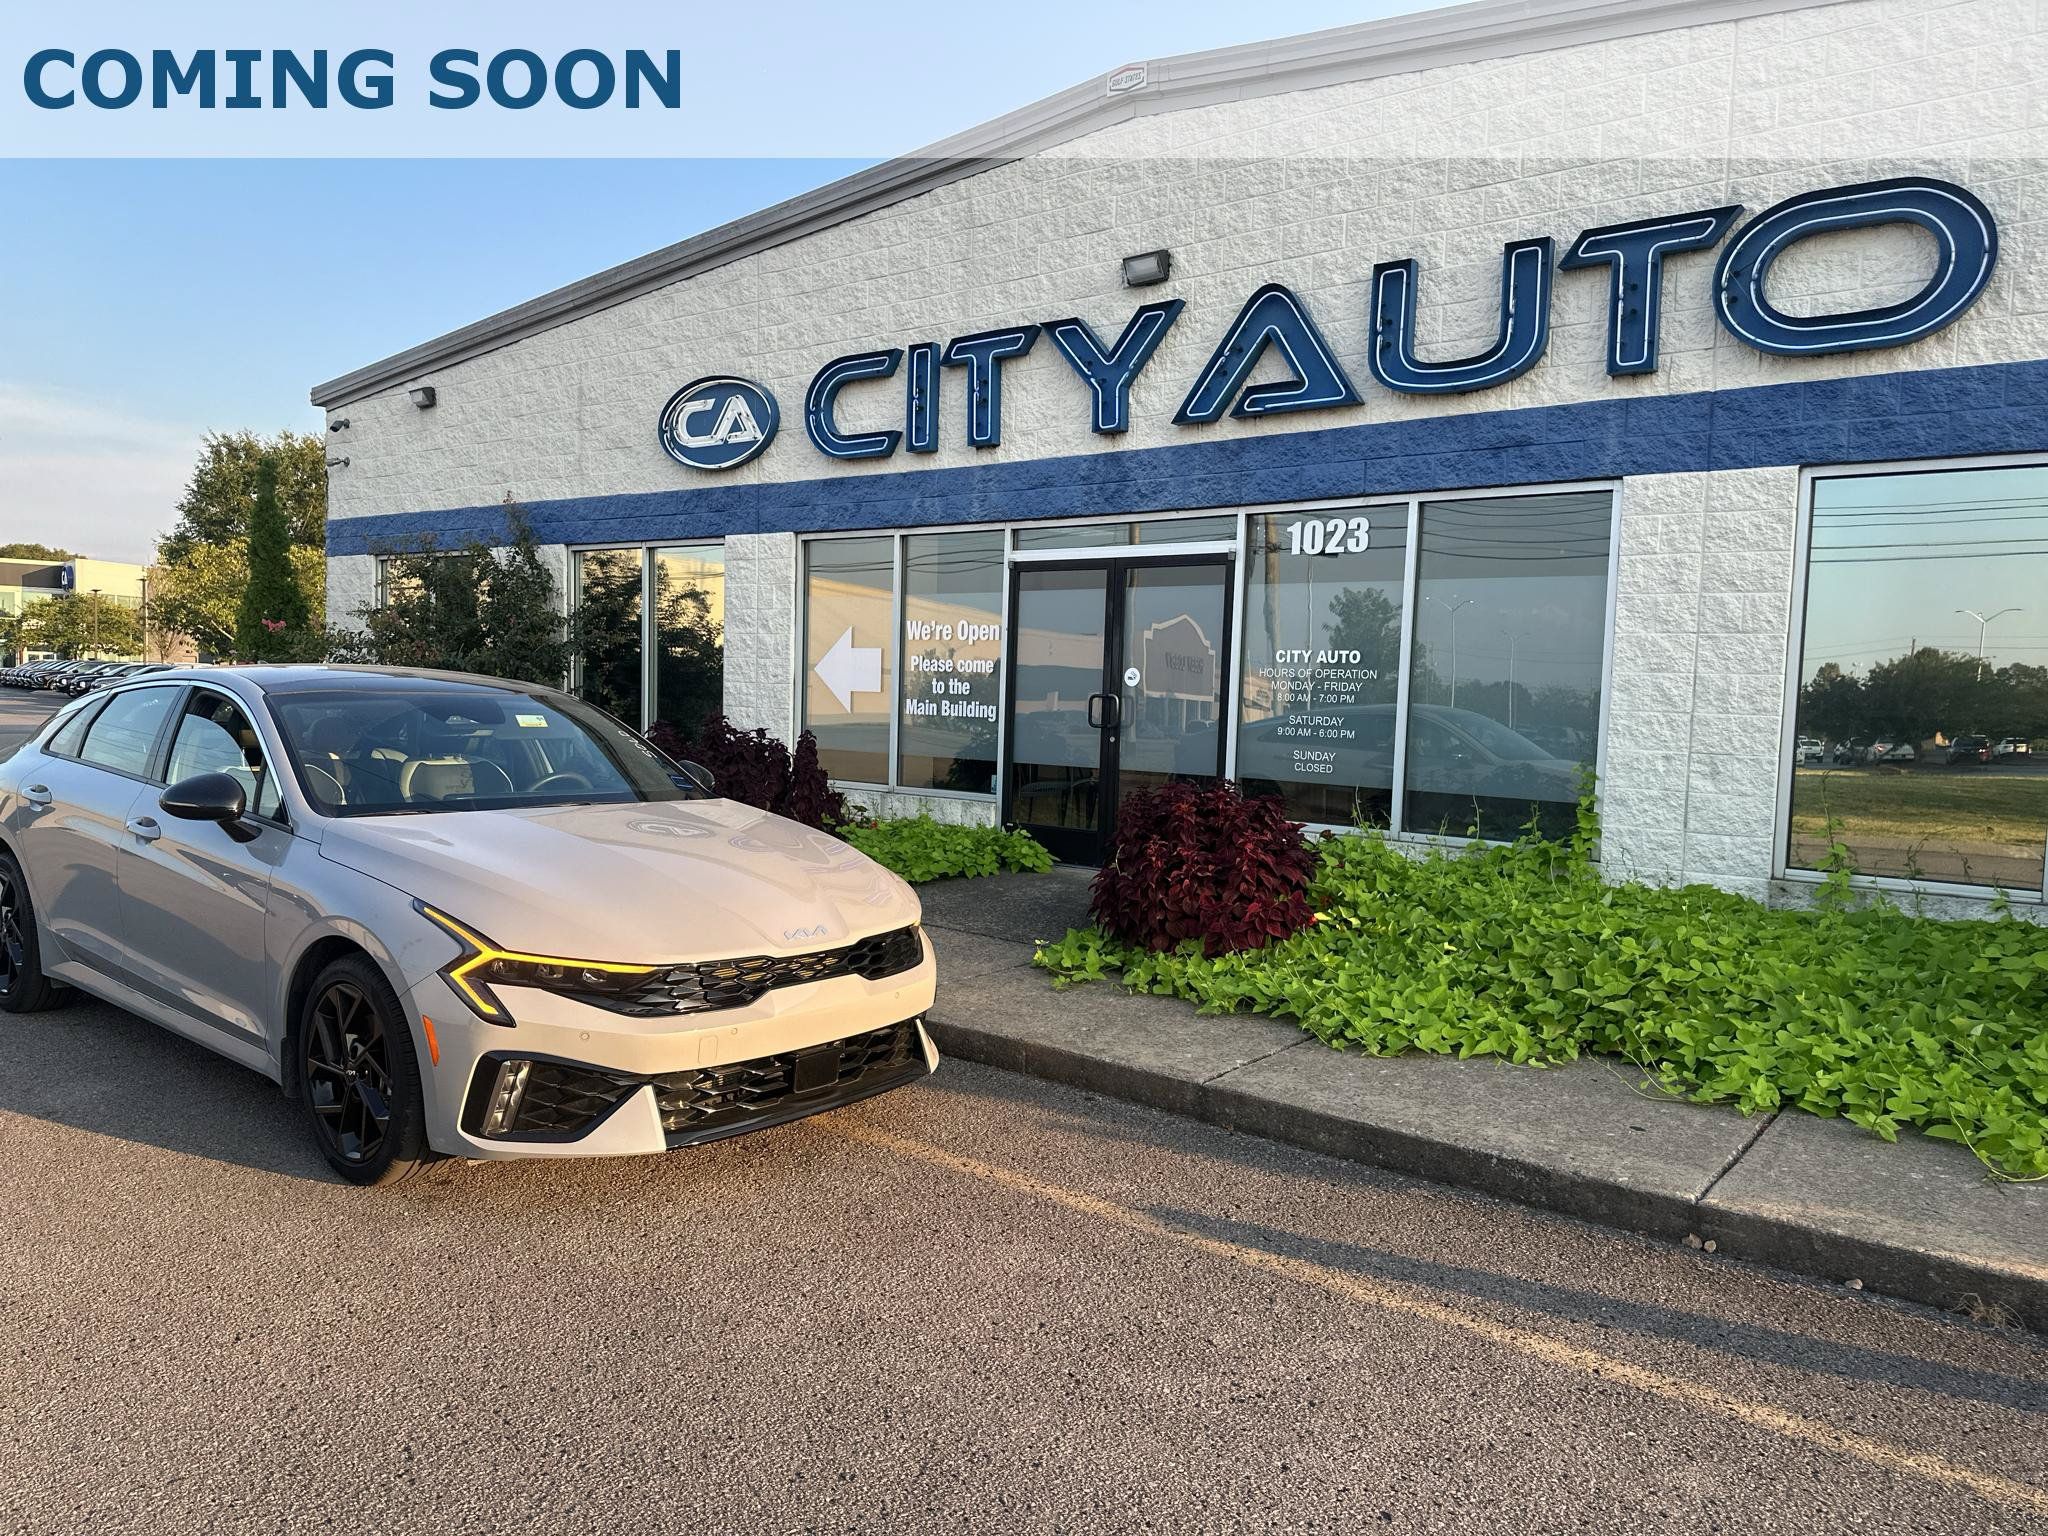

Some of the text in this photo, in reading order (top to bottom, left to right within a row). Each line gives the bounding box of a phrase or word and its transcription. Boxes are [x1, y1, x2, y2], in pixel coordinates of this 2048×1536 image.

[804, 176, 1999, 459] CITY AUTO
[675, 393, 764, 449] CA
[1287, 517, 1370, 555] 1023
[957, 619, 1001, 646] Open
[910, 655, 994, 673] Please come
[1275, 649, 1361, 664] CITY AUTO
[1259, 667, 1377, 680] HOURS OF OPERATION
[932, 677, 971, 695] to the
[1271, 681, 1315, 691] MONDAY
[1324, 681, 1363, 692] FRIDAY
[1277, 693, 1295, 702] 8:00
[1296, 693, 1310, 702] AM
[1319, 693, 1338, 703] 7:00
[1340, 694, 1355, 704] PM
[906, 698, 997, 722] Main Building
[1289, 715, 1344, 727] SATURDAY
[1277, 726, 1295, 736] 9:00
[1297, 728, 1311, 737] AM
[1319, 728, 1338, 738] 6:00
[1340, 729, 1355, 739] PM
[1293, 750, 1336, 762] SUNDAY
[1294, 762, 1333, 773] CLOSED
